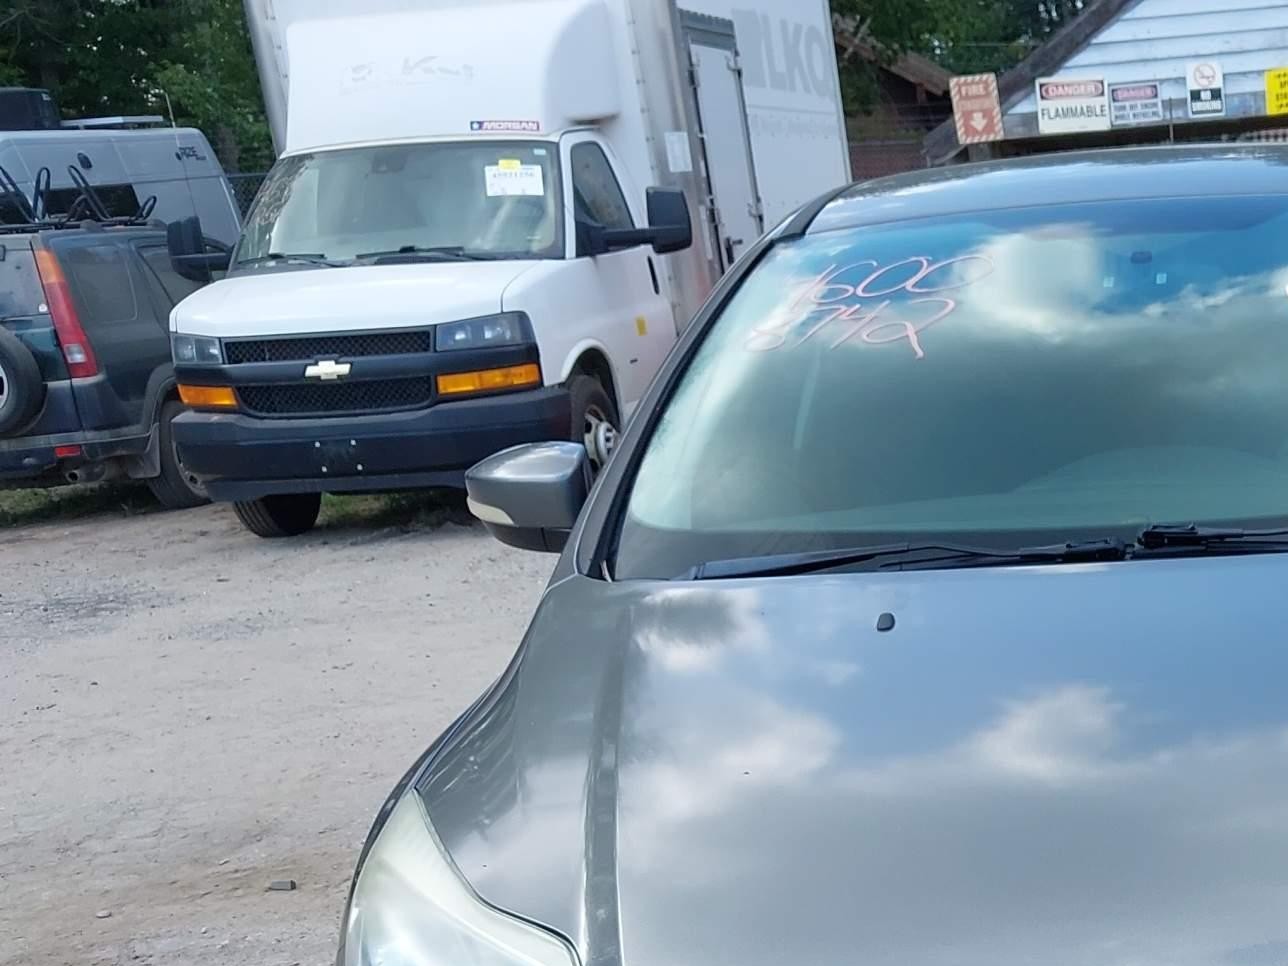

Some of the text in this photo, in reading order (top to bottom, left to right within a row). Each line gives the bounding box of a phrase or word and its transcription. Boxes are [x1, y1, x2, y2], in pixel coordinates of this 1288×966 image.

[960, 84, 987, 97] FIRE
[1048, 84, 1099, 97] DANGER
[1041, 104, 1107, 120] FLAMMABLE
